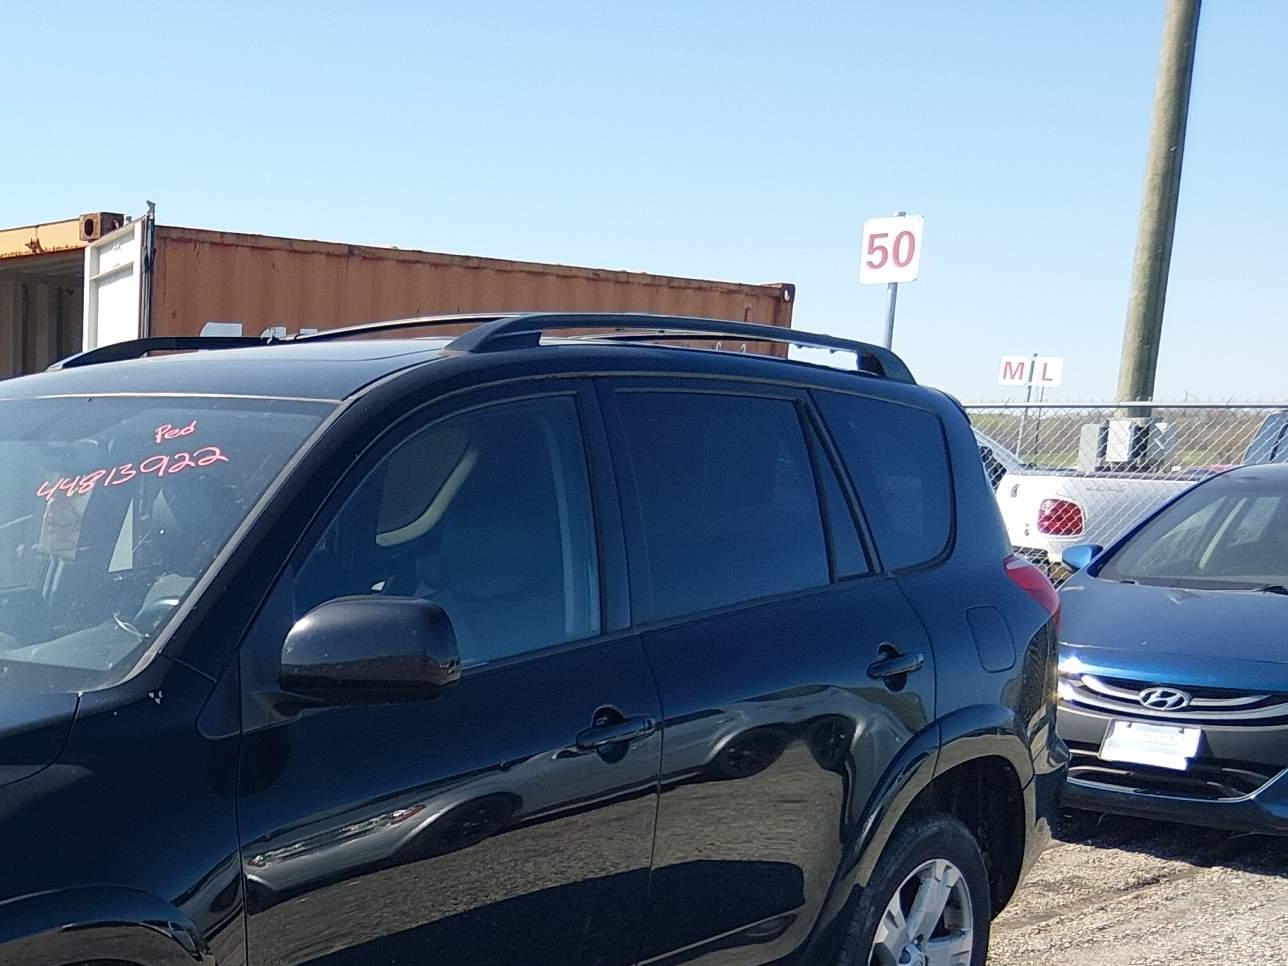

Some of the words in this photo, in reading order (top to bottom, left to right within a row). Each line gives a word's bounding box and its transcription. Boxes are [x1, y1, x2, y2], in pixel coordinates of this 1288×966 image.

[866, 230, 915, 270] 50
[1003, 361, 1025, 380] M
[1041, 362, 1053, 381] L
[36, 447, 229, 500] 44813922
